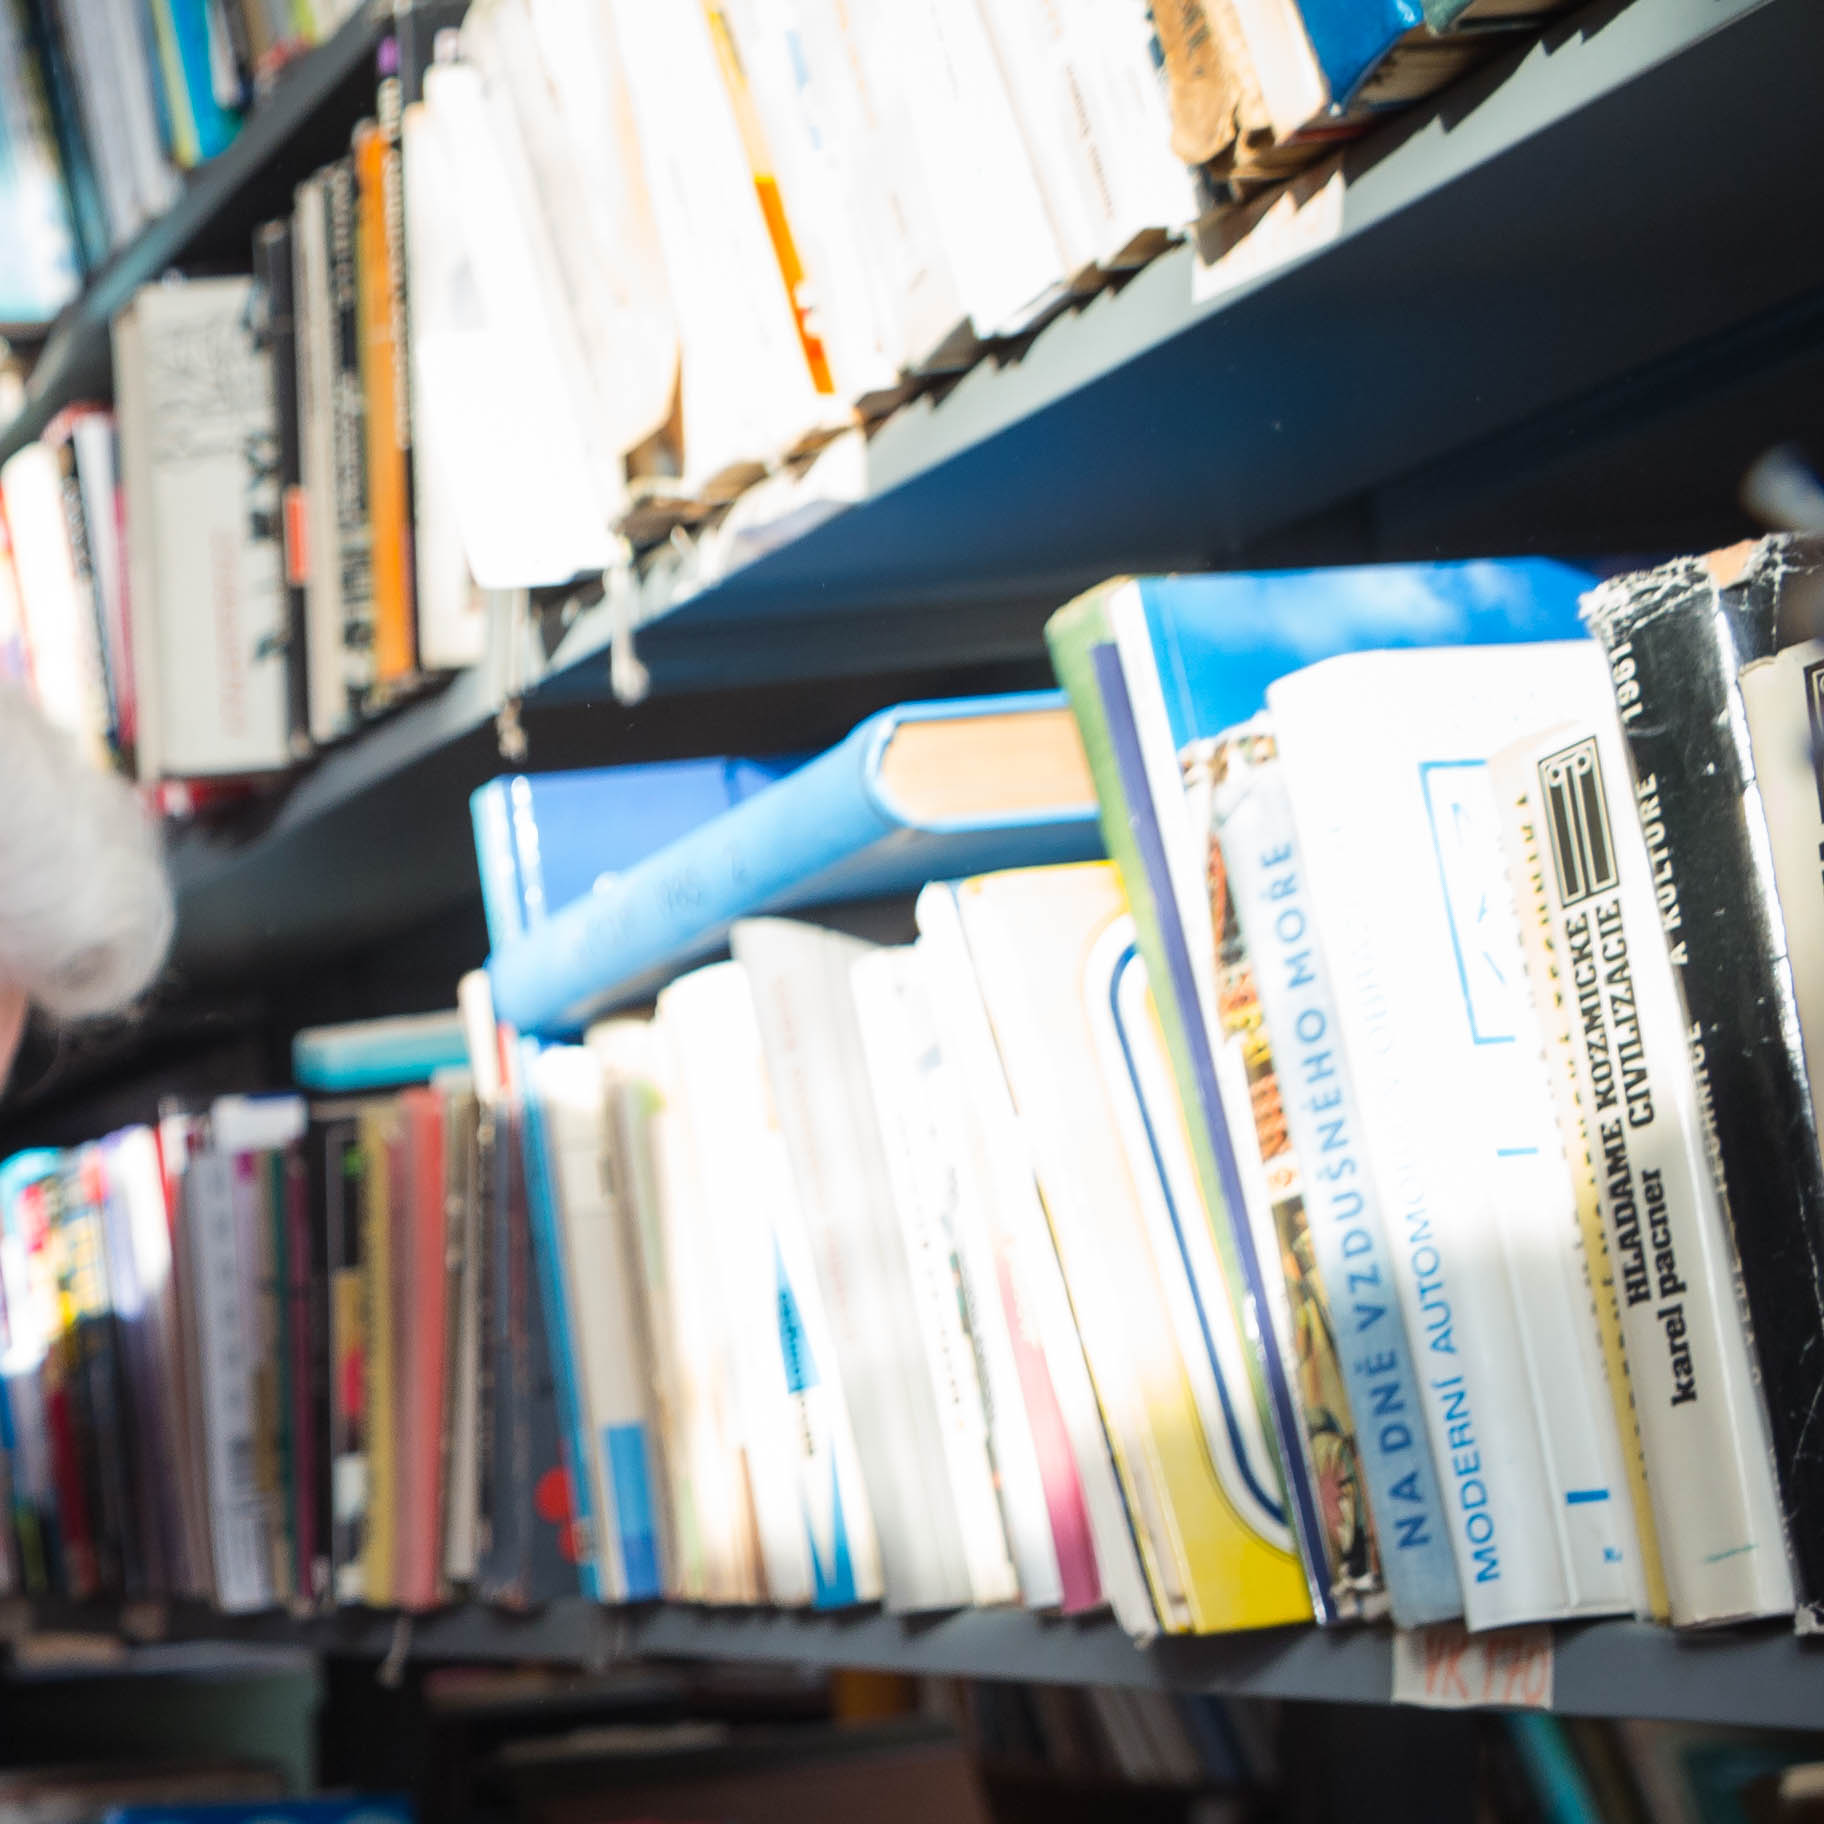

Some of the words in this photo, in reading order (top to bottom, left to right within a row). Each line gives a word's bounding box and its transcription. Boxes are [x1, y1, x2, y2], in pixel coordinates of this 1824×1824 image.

[1258, 840, 1318, 986] MOŘE
[1288, 1004, 1389, 1332] VZDUŠNÉHO
[1635, 1164, 1687, 1298] pacner
[1355, 1346, 1413, 1453] DNĚ
[1654, 1302, 1699, 1405] karel
[1384, 1467, 1432, 1551] NA
[1429, 1372, 1506, 1584] MODERNÍ
